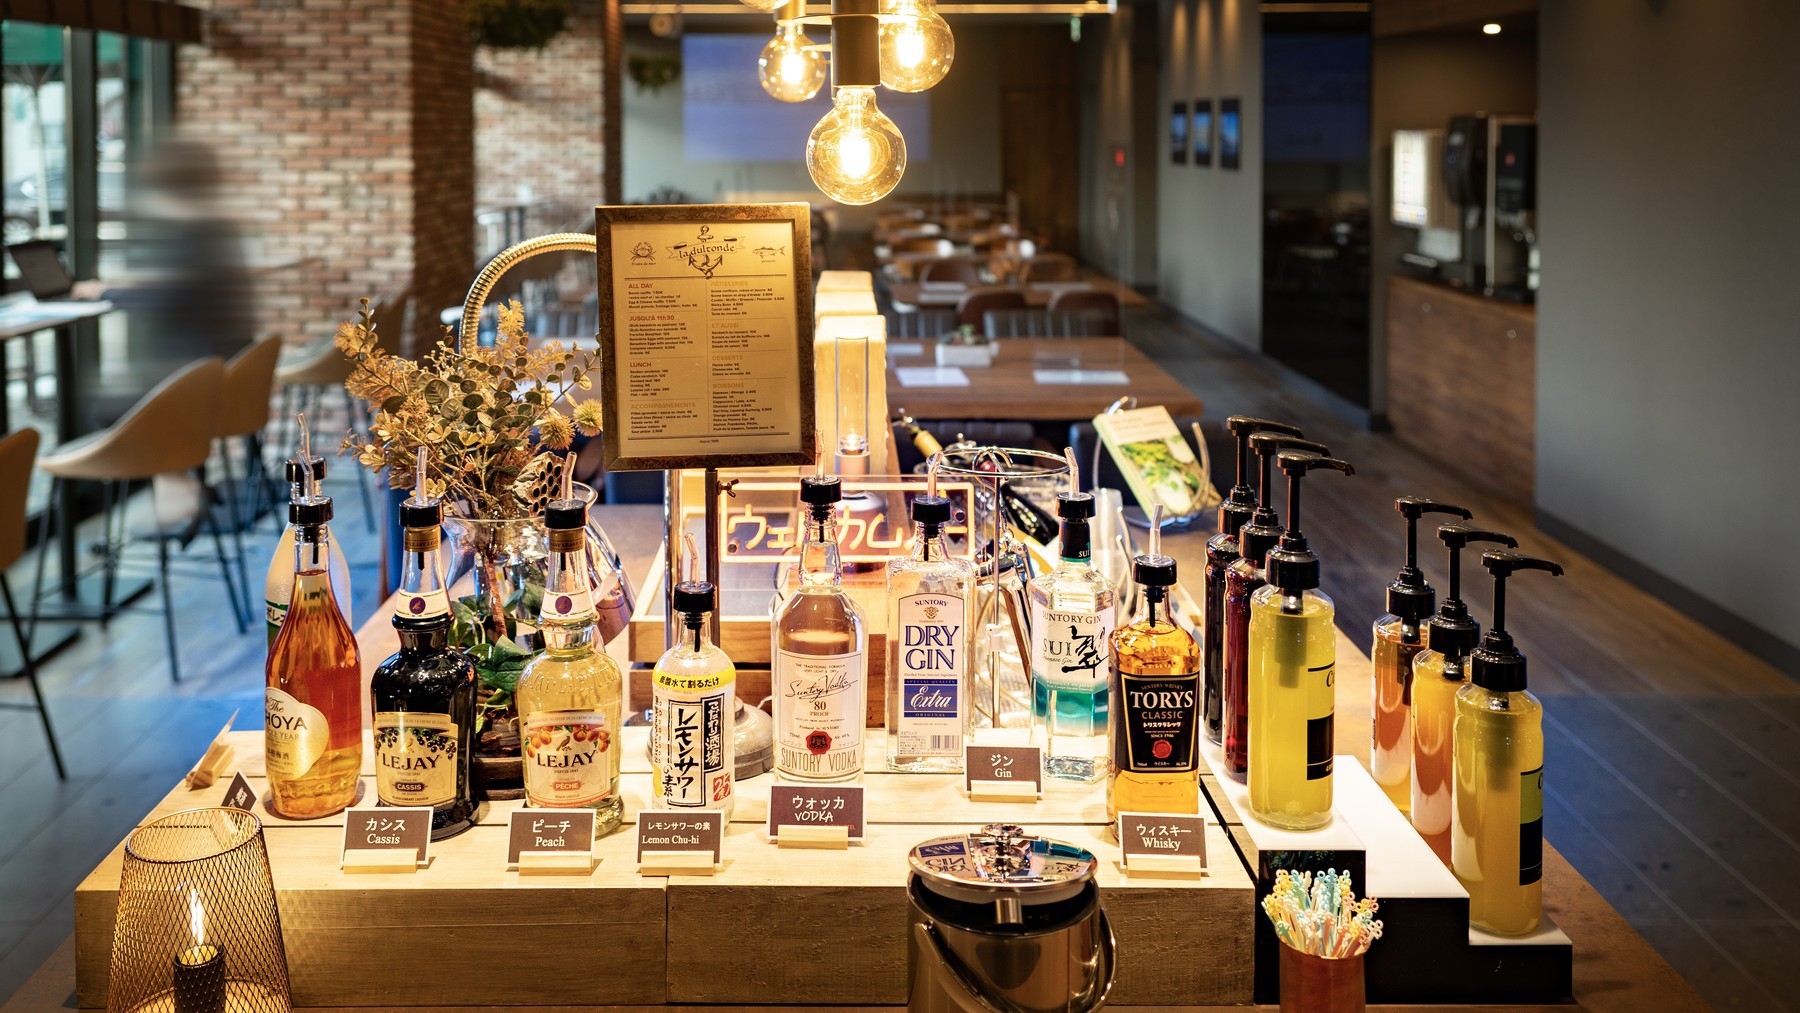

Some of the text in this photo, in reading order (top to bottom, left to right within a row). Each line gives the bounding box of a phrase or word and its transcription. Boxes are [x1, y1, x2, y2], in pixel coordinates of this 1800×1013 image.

[1043, 610, 1102, 624] SUNTORY GIN
[905, 626, 960, 646] DRY
[1043, 638, 1072, 656] SUI
[906, 648, 955, 670] GIN
[814, 701, 826, 710] 80
[911, 686, 952, 710] Extra
[1130, 690, 1194, 708] TORYS
[1142, 711, 1183, 719] CLASSIC
[704, 701, 721, 766] こだわり酒場
[537, 750, 596, 768] LEJAY
[674, 708, 699, 799] レモンサワー
[782, 748, 856, 772] SUNTORY VODKA
[990, 754, 1014, 767] ジン
[382, 753, 440, 770] LEJAY
[994, 768, 1013, 778] Gin
[792, 795, 844, 810] ウォッカ
[794, 810, 834, 822] VODKA
[365, 818, 406, 831] カシス
[532, 818, 571, 833] ピーチ
[648, 822, 711, 830] レモンサワーの素
[1136, 824, 1192, 837] ウィスキー
[366, 833, 401, 844] Cassis
[535, 836, 565, 847] Peach
[642, 835, 700, 844] Lemon Chu-hi
[1142, 837, 1181, 852] Whisky
